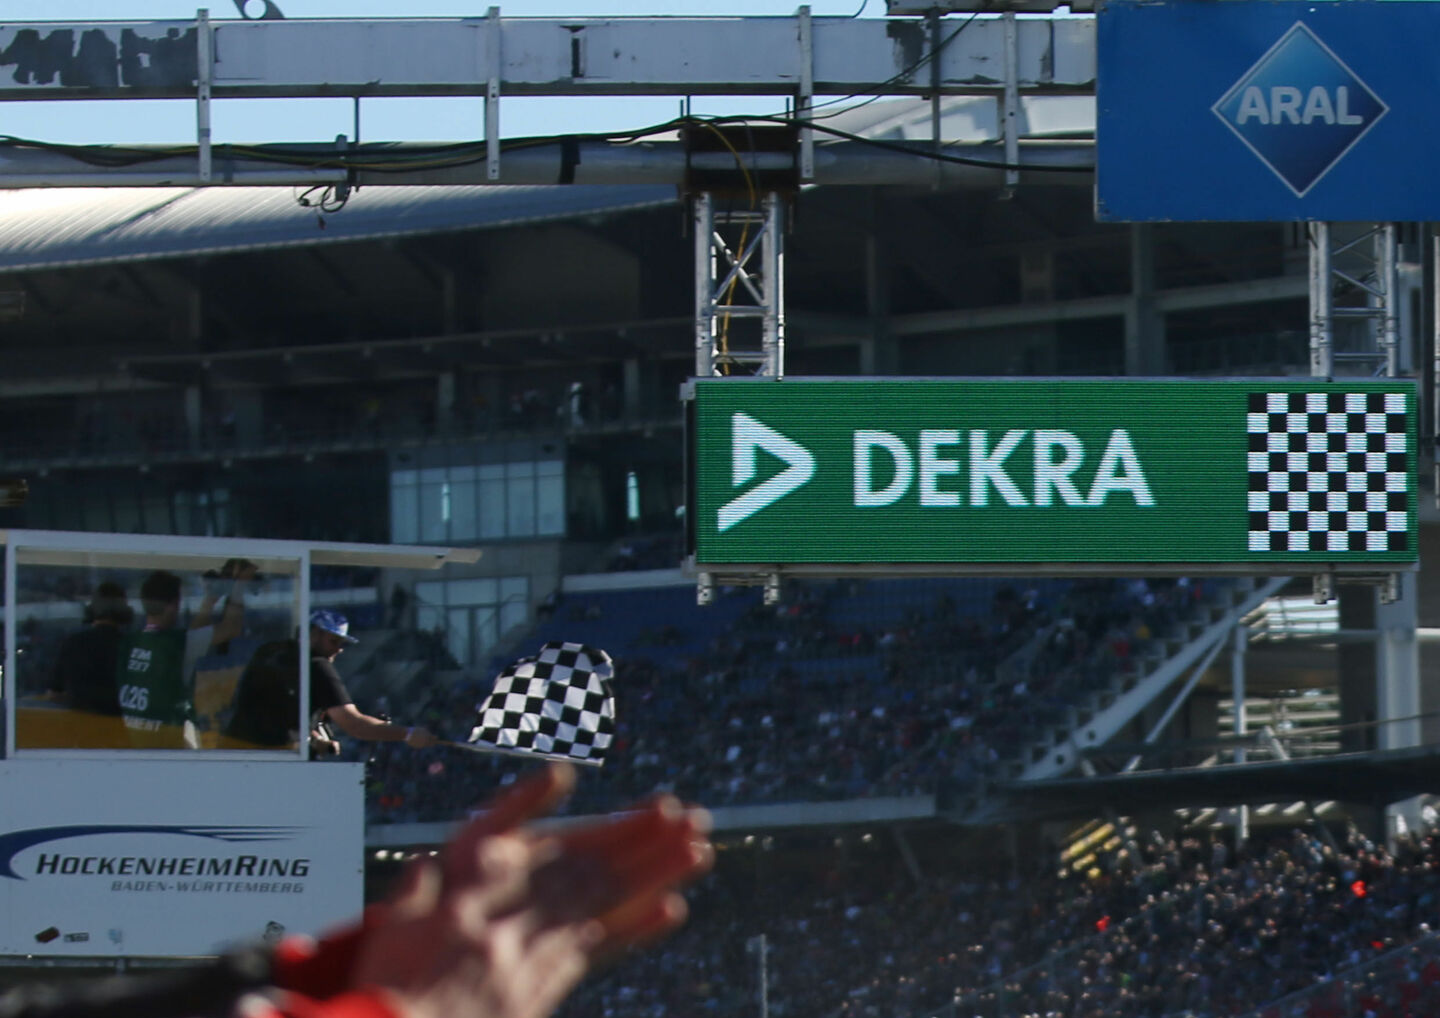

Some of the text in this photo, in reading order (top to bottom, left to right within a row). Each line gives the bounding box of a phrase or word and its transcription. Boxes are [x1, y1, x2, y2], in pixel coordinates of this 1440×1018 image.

[1236, 85, 1363, 126] ARAL
[853, 428, 1156, 507] DEKRA
[36, 854, 311, 878] HOCKENHEIMRING
